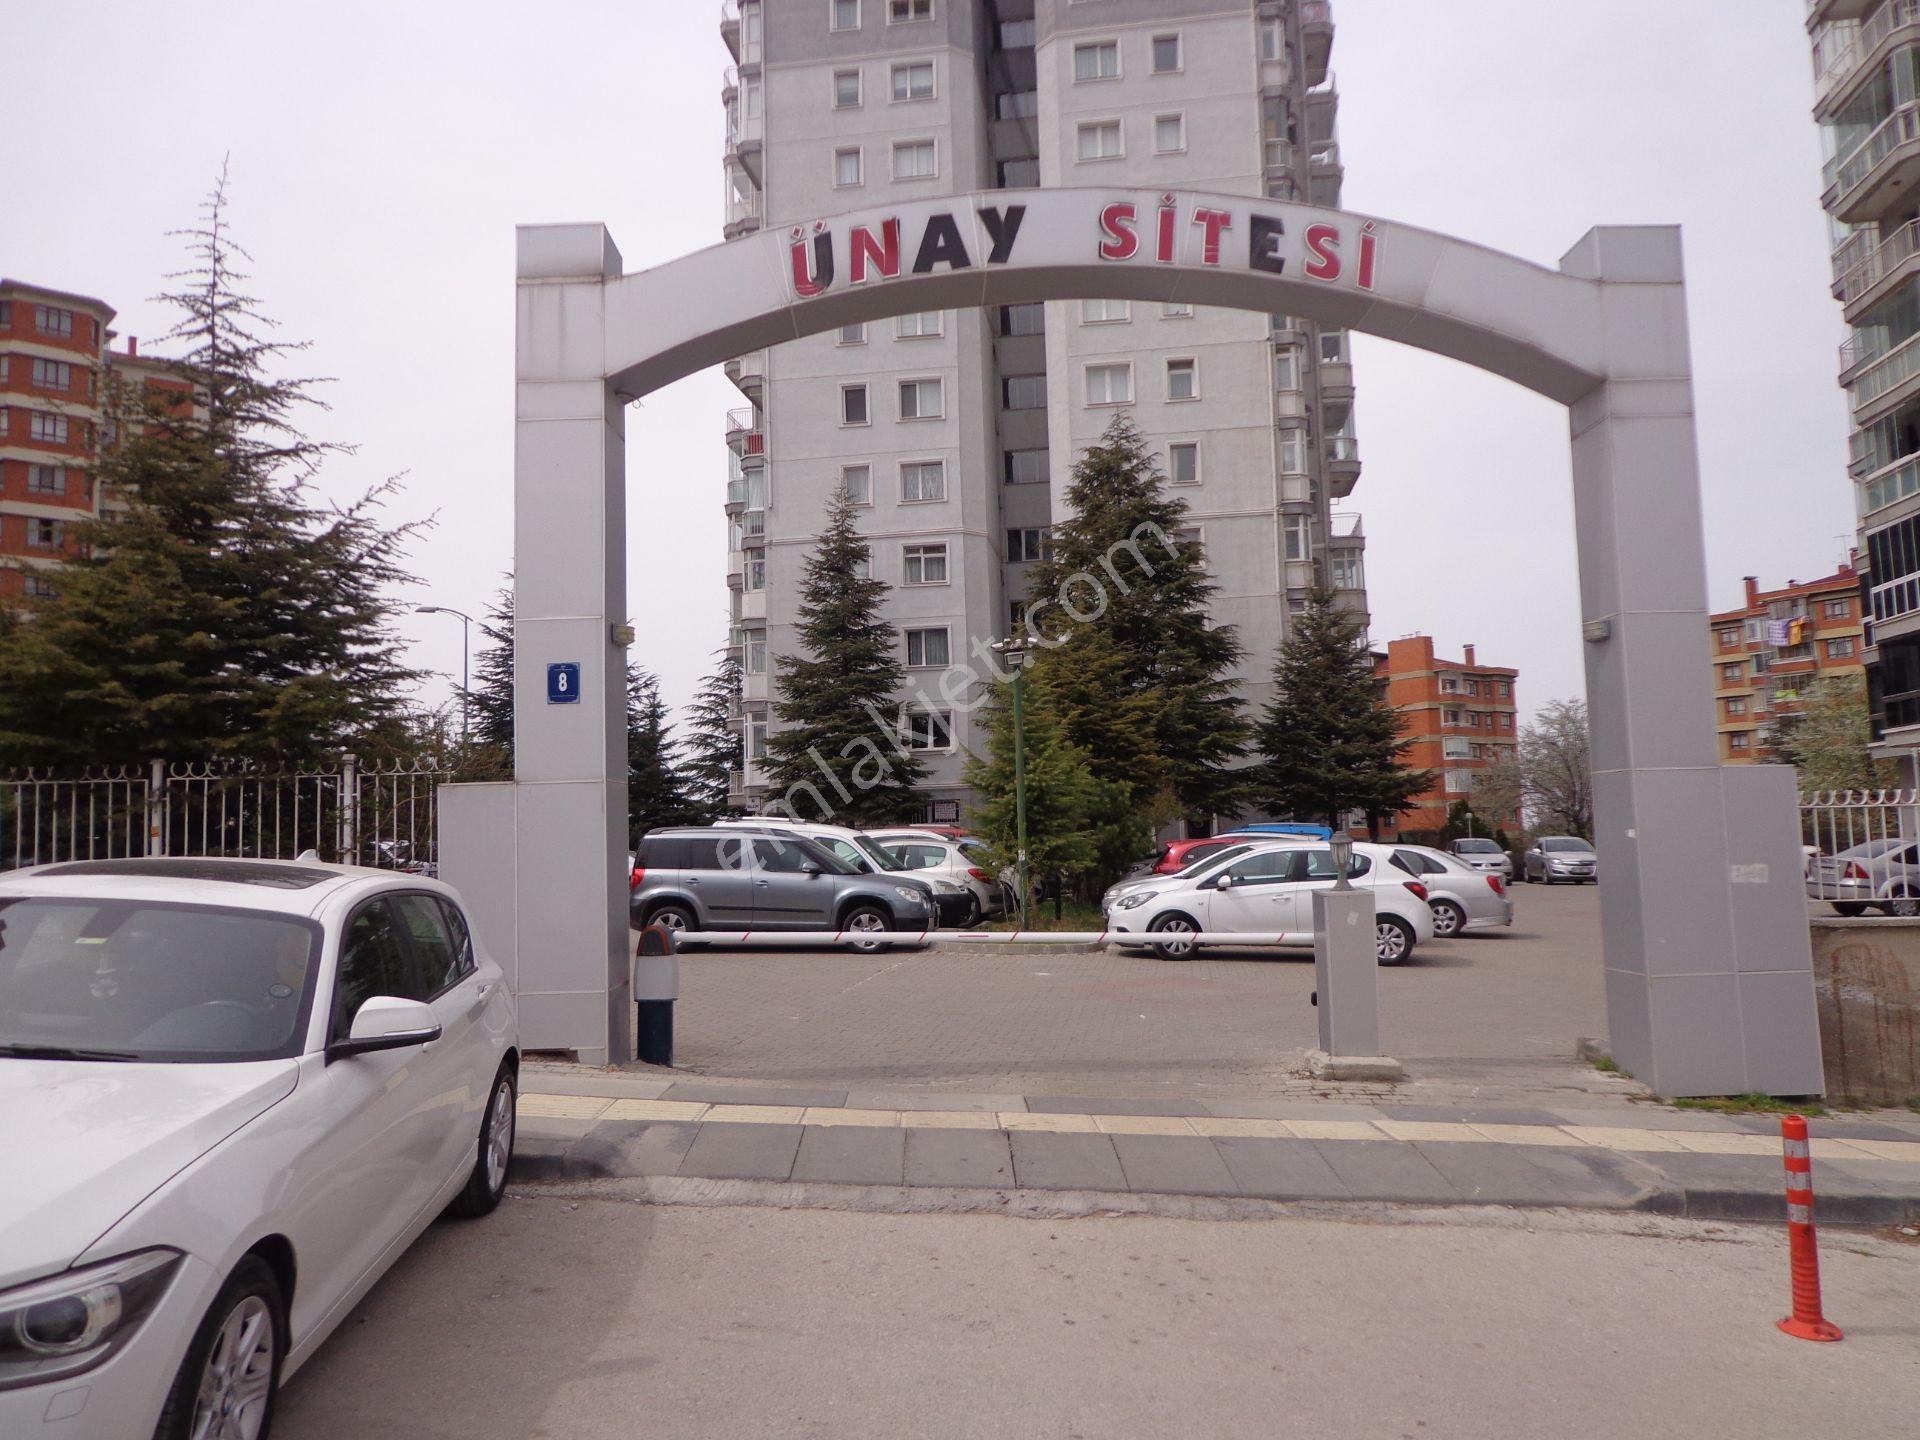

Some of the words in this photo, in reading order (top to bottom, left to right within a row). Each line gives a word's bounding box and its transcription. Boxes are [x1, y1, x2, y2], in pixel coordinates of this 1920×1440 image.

[790, 206, 1027, 298] ÜNAY
[1099, 192, 1377, 291] SİTESİ
[558, 672, 568, 692] 8
